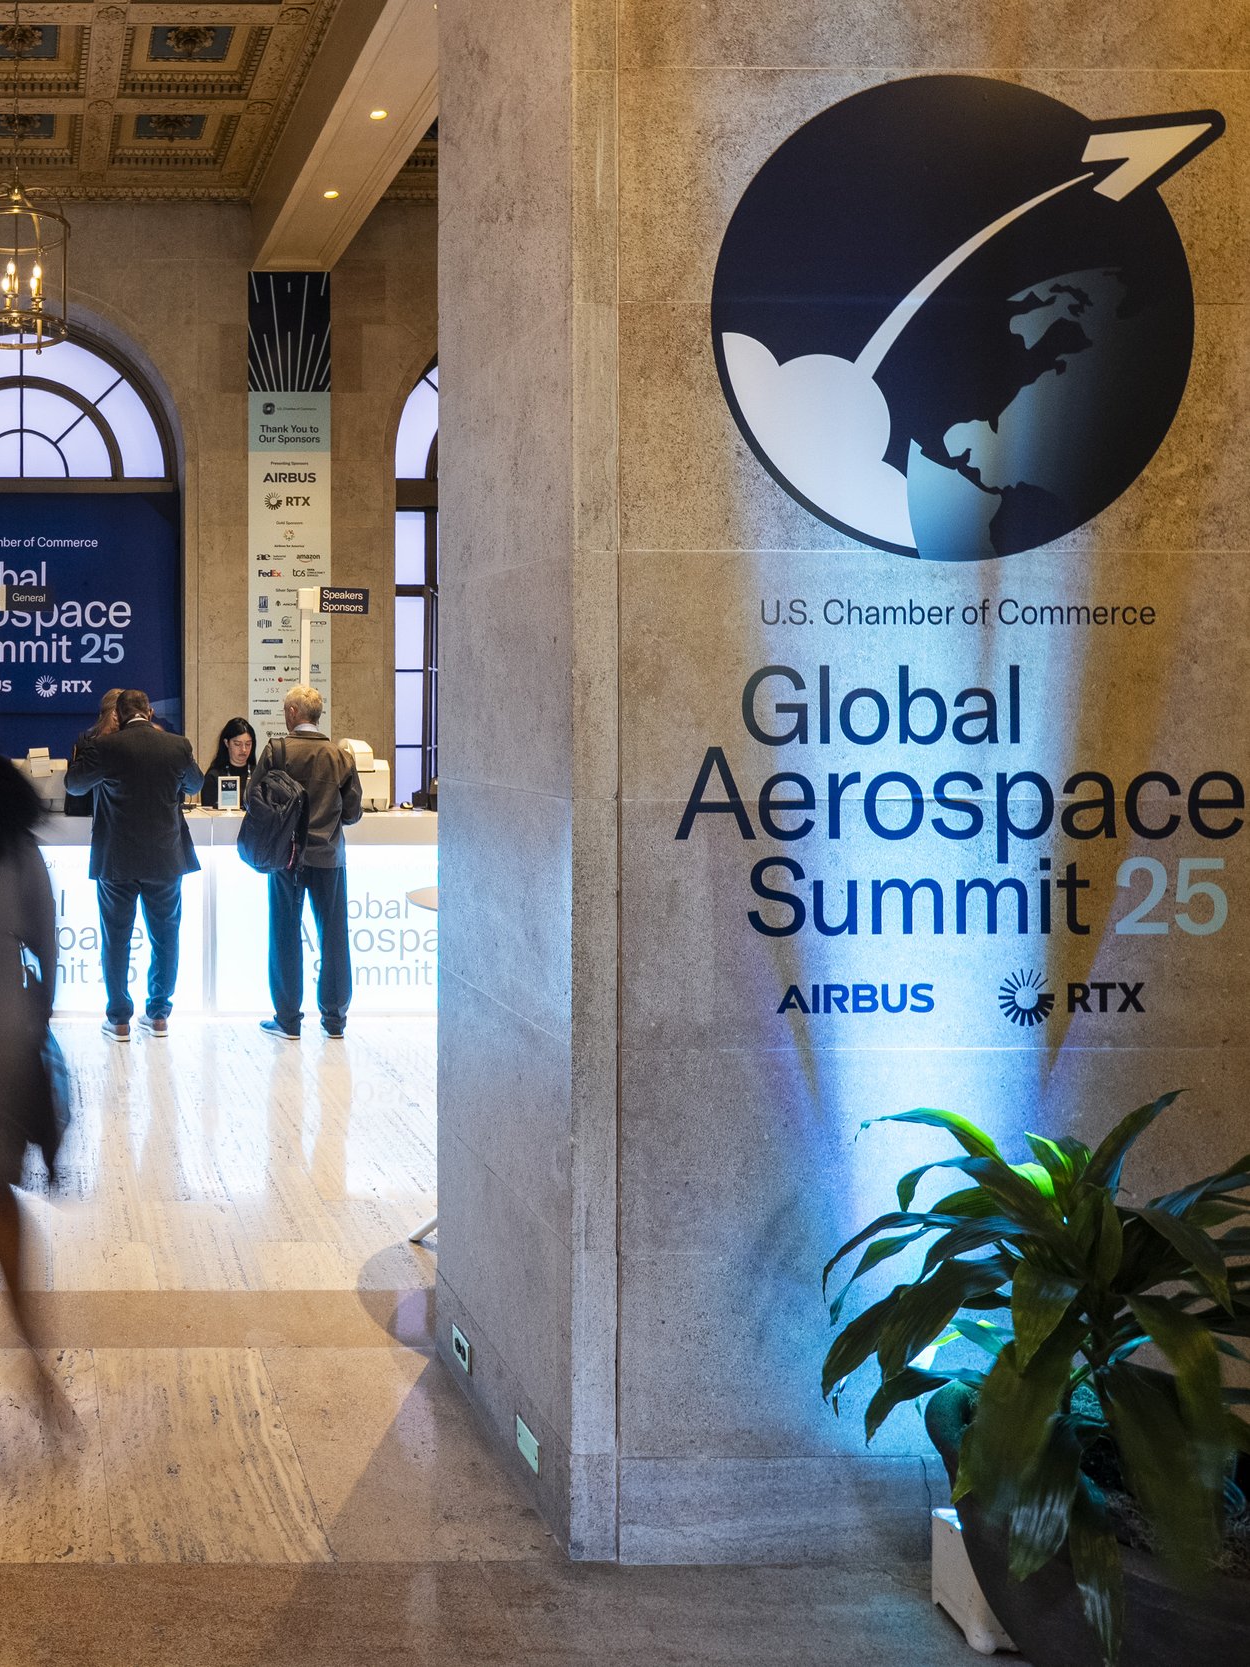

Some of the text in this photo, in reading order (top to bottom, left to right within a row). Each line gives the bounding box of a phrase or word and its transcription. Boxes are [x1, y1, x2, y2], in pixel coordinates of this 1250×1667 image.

[260, 425, 319, 434] Thank You to
[258, 434, 320, 444] Our Sponsors
[263, 473, 316, 483] AIRBUS
[286, 496, 310, 506] RTX
[23, 537, 35, 548] of
[37, 537, 98, 548] Commerce
[258, 570, 282, 578] FedEx
[12, 592, 46, 603] General
[322, 590, 364, 600] Speakers
[322, 602, 364, 612] Sponsors
[761, 598, 1156, 626] U.S. Chamber of Commerce
[80, 633, 125, 664] 25
[61, 680, 92, 693] RTX
[742, 664, 1020, 746] Global
[675, 746, 1245, 864] Aerospace
[747, 856, 1228, 937] Summit 25
[776, 983, 935, 1014] AIRBUS
[1067, 982, 1145, 1013] RTX
